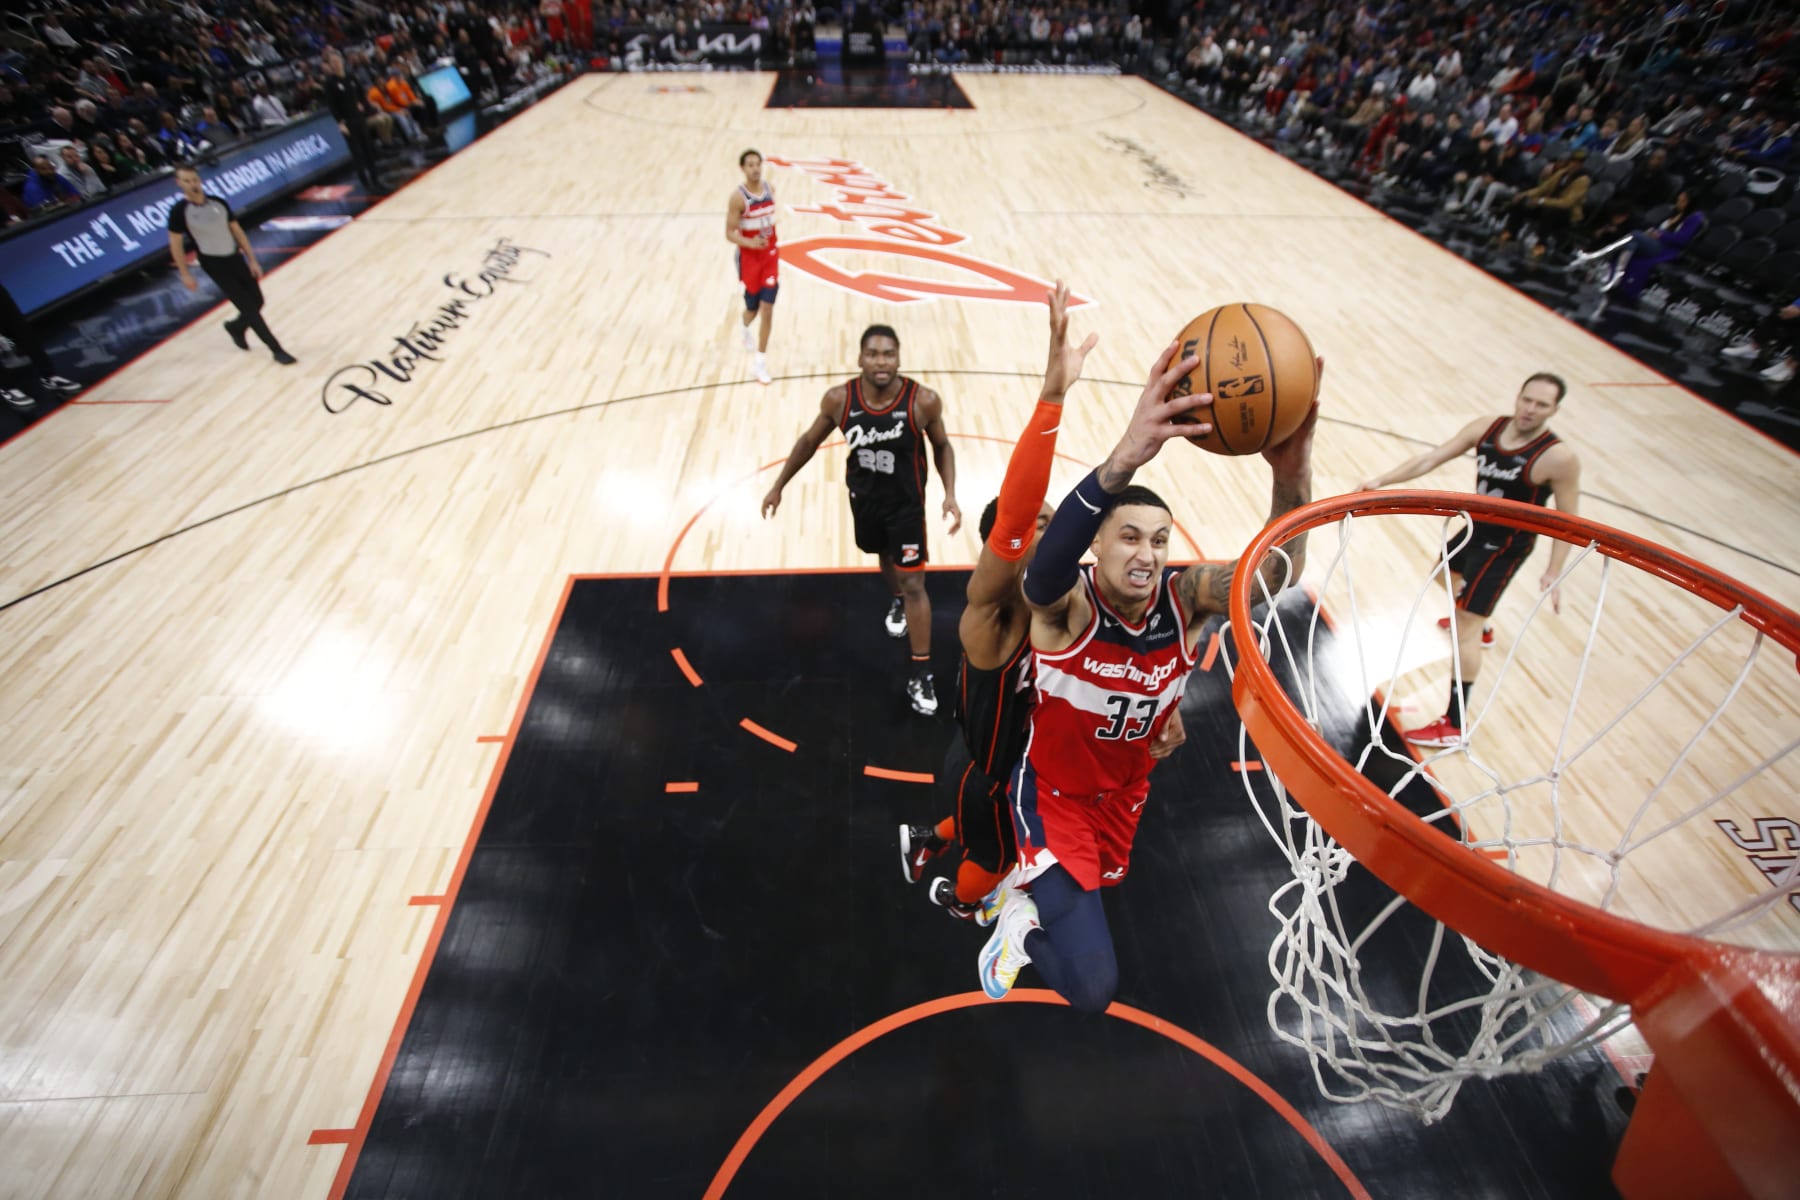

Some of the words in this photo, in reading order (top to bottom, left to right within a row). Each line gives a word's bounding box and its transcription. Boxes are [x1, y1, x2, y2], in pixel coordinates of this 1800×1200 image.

[52, 232, 106, 269] THE
[98, 212, 142, 252] #1
[215, 158, 275, 198] LENDER
[267, 151, 284, 174] IN
[281, 133, 331, 171] AMERICA
[322, 299, 470, 415] Platinum
[443, 236, 552, 301] Equity
[845, 419, 905, 450] Detroit
[857, 448, 896, 475] 28
[1082, 656, 1178, 692] washington
[1094, 694, 1160, 742] 33
